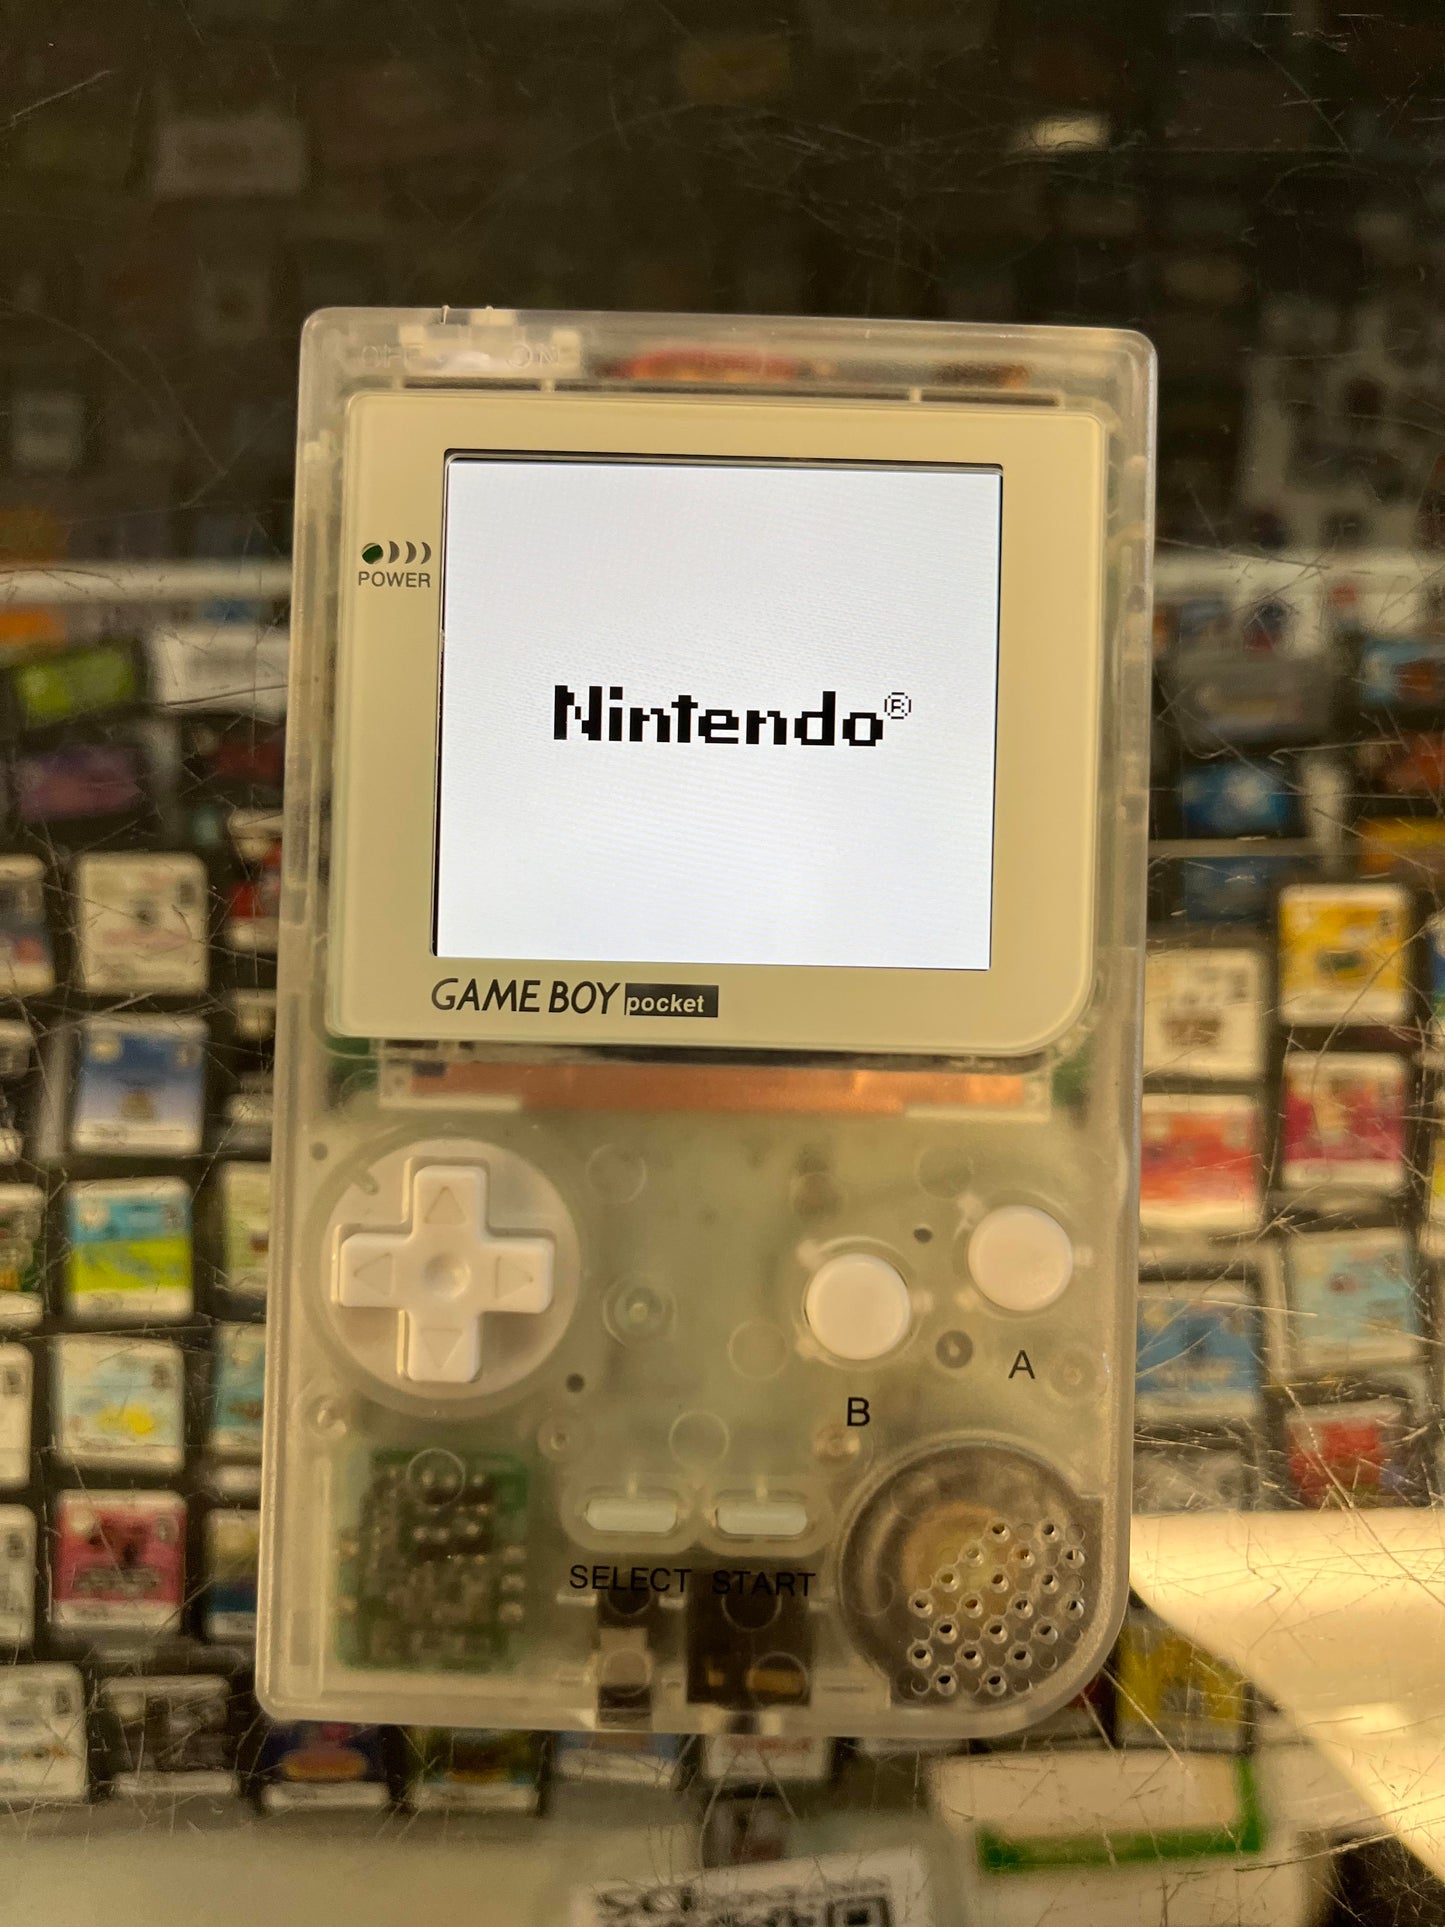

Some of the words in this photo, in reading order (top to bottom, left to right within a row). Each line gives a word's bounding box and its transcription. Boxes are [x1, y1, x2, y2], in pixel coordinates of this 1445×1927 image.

[505, 342, 561, 369] ON
[358, 571, 431, 588] POWER
[431, 977, 541, 1013] GAME
[548, 980, 621, 1015] BOY
[627, 994, 705, 1016] pocket
[1008, 1349, 1036, 1379] A
[846, 1396, 871, 1427] B
[569, 1565, 693, 1593] SELECT
[711, 1570, 816, 1597] START
